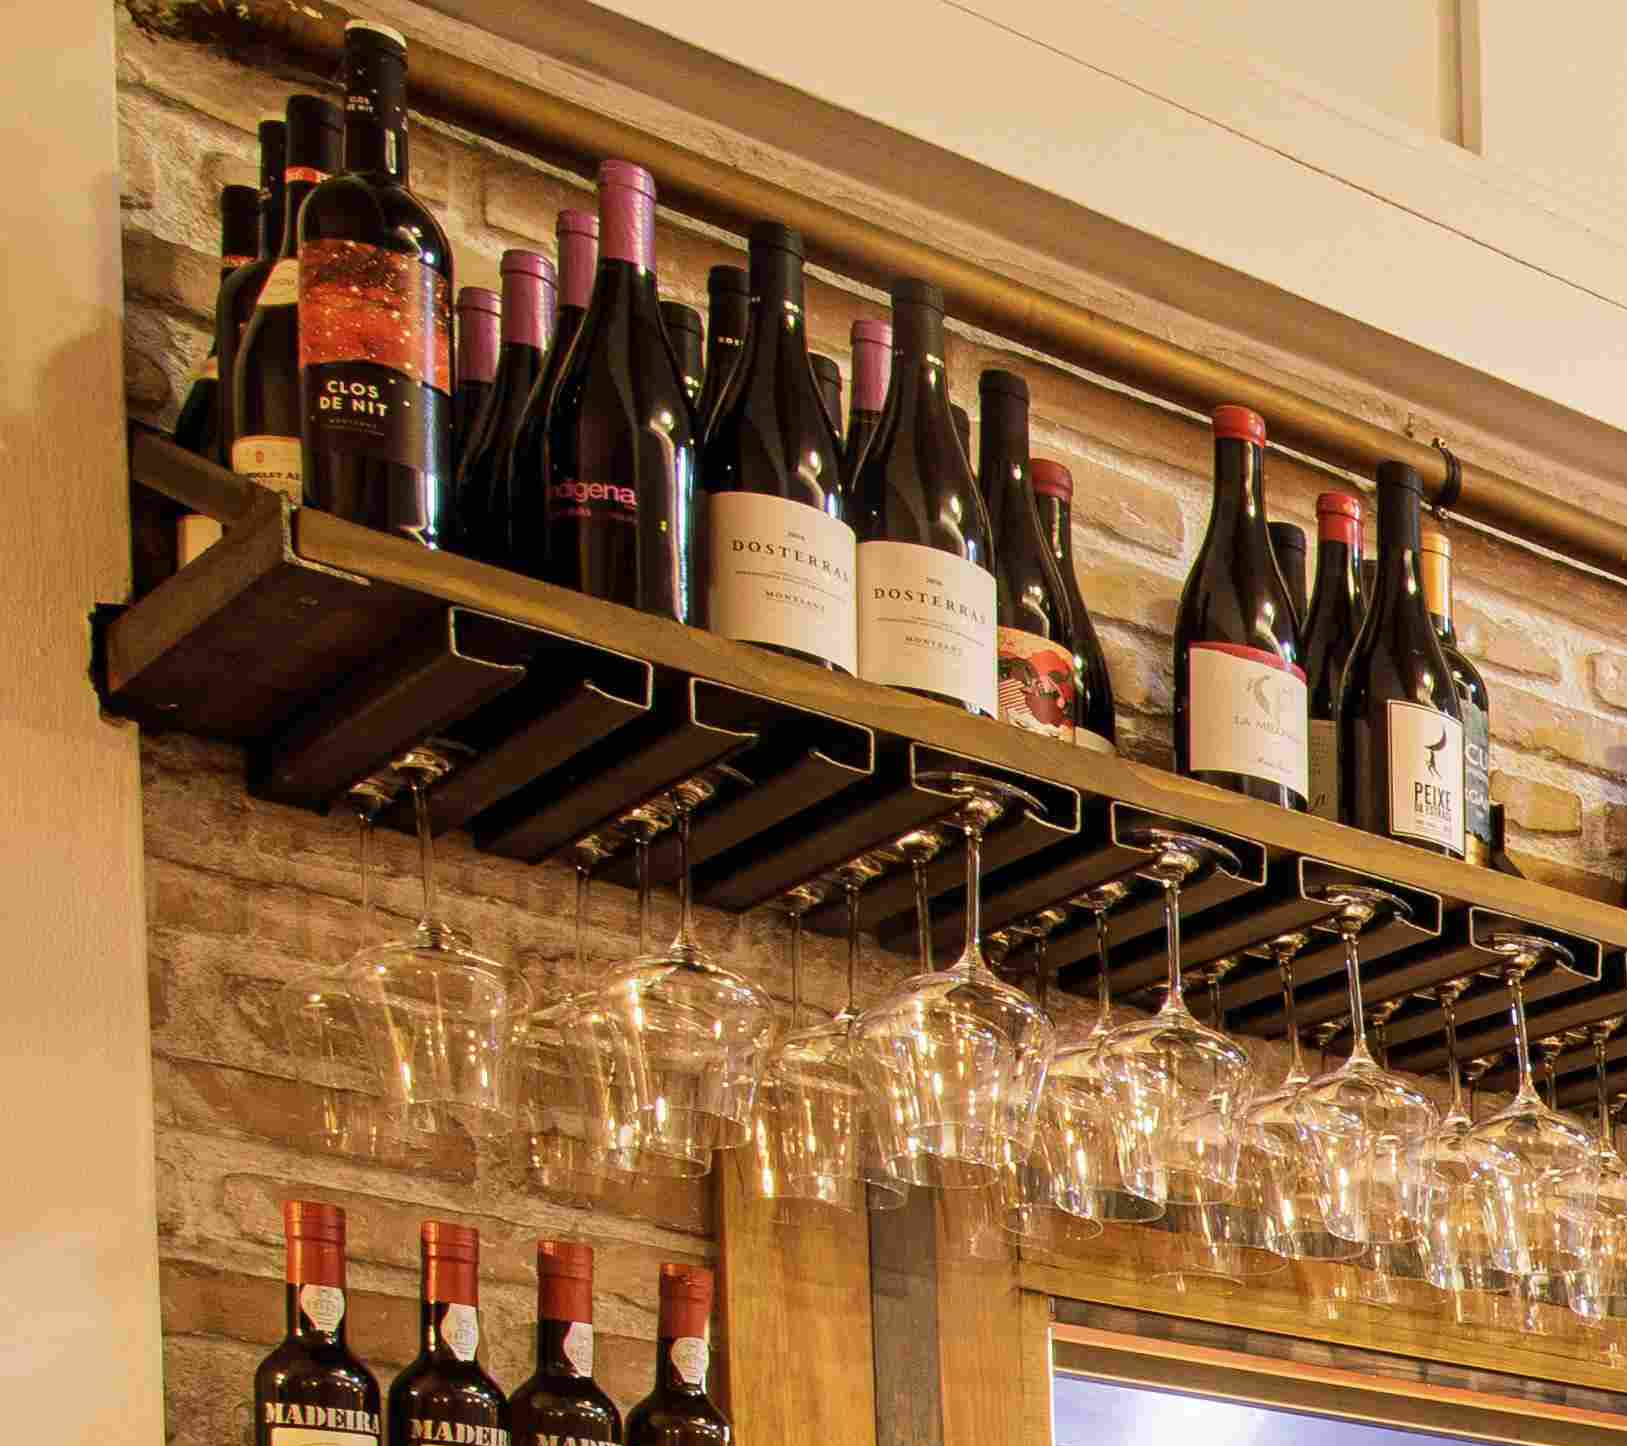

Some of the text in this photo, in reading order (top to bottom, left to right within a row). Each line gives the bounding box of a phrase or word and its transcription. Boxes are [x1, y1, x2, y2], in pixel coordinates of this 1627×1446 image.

[327, 379, 379, 399] CLOS
[319, 396, 389, 417] DE NIT
[732, 539, 848, 582] DOSTERRAS
[874, 587, 985, 625] DOSTERRAS
[1414, 781, 1451, 812] PEIXE
[265, 1402, 381, 1435] MADEIRA
